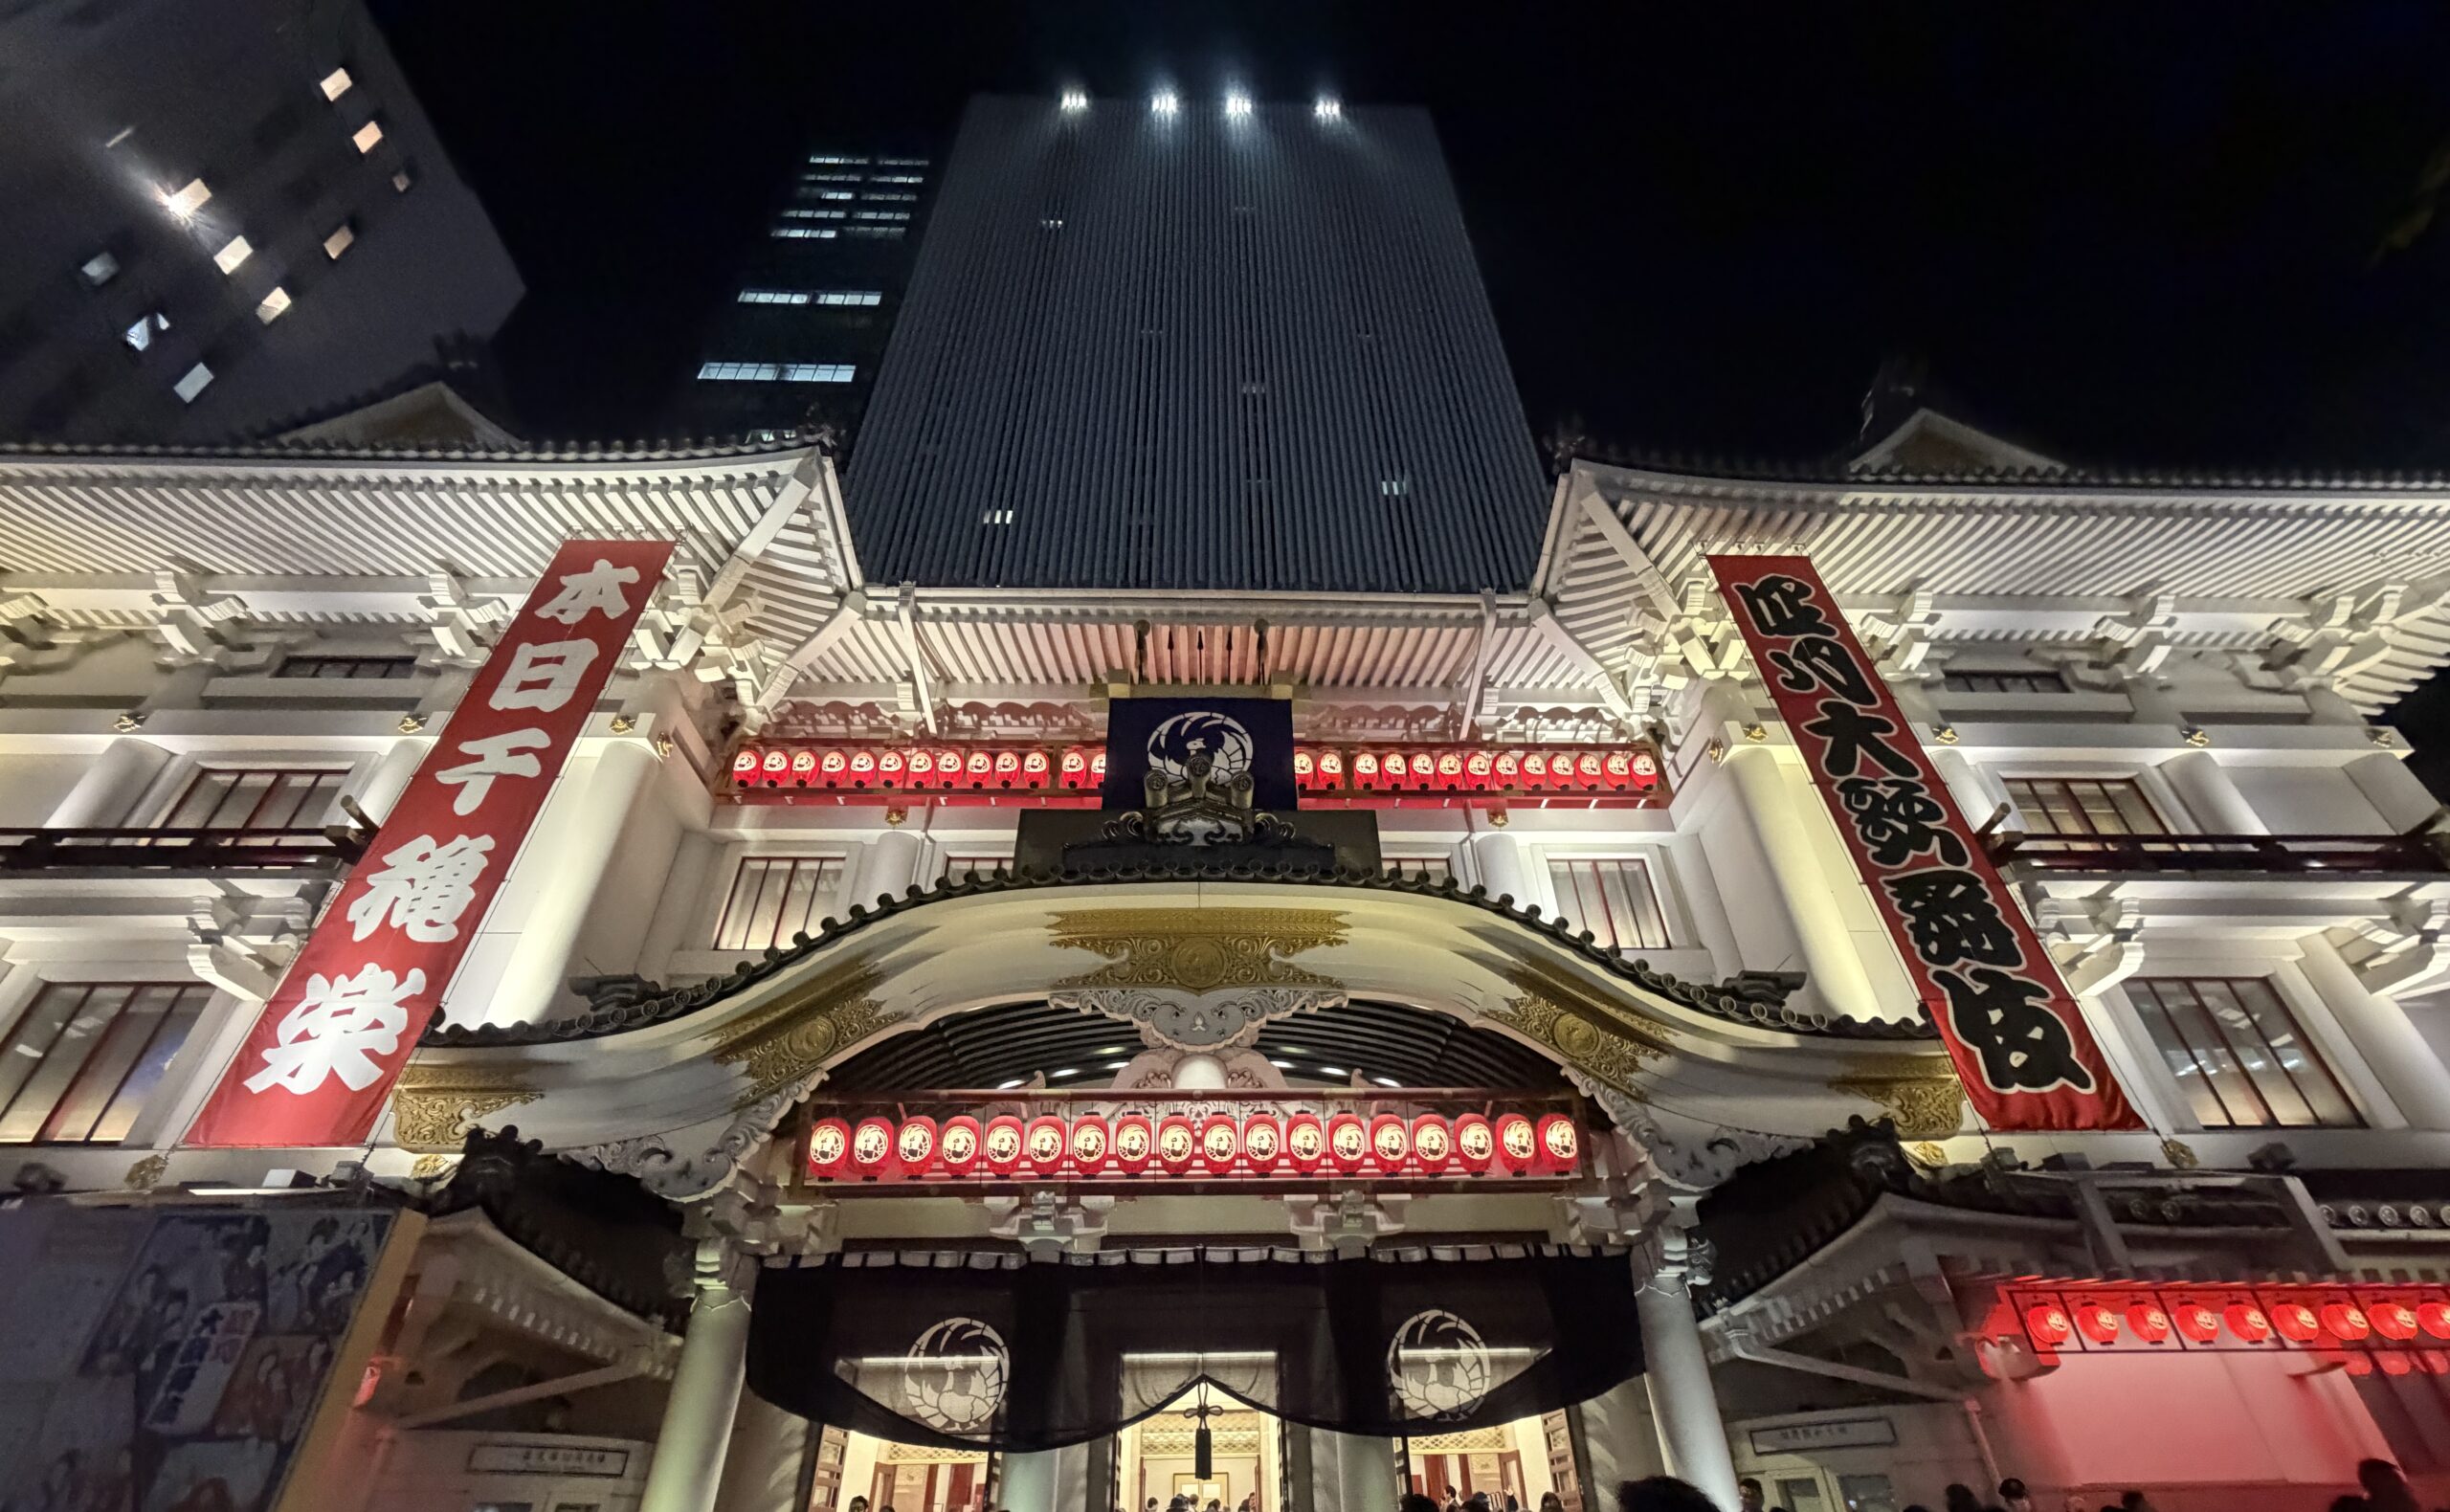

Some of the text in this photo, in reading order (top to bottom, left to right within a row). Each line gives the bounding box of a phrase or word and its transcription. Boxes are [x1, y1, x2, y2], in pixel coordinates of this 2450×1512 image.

[242, 558, 640, 1096] 本日千穐楽
[1731, 572, 2097, 1095] 四月大歌舞伎
